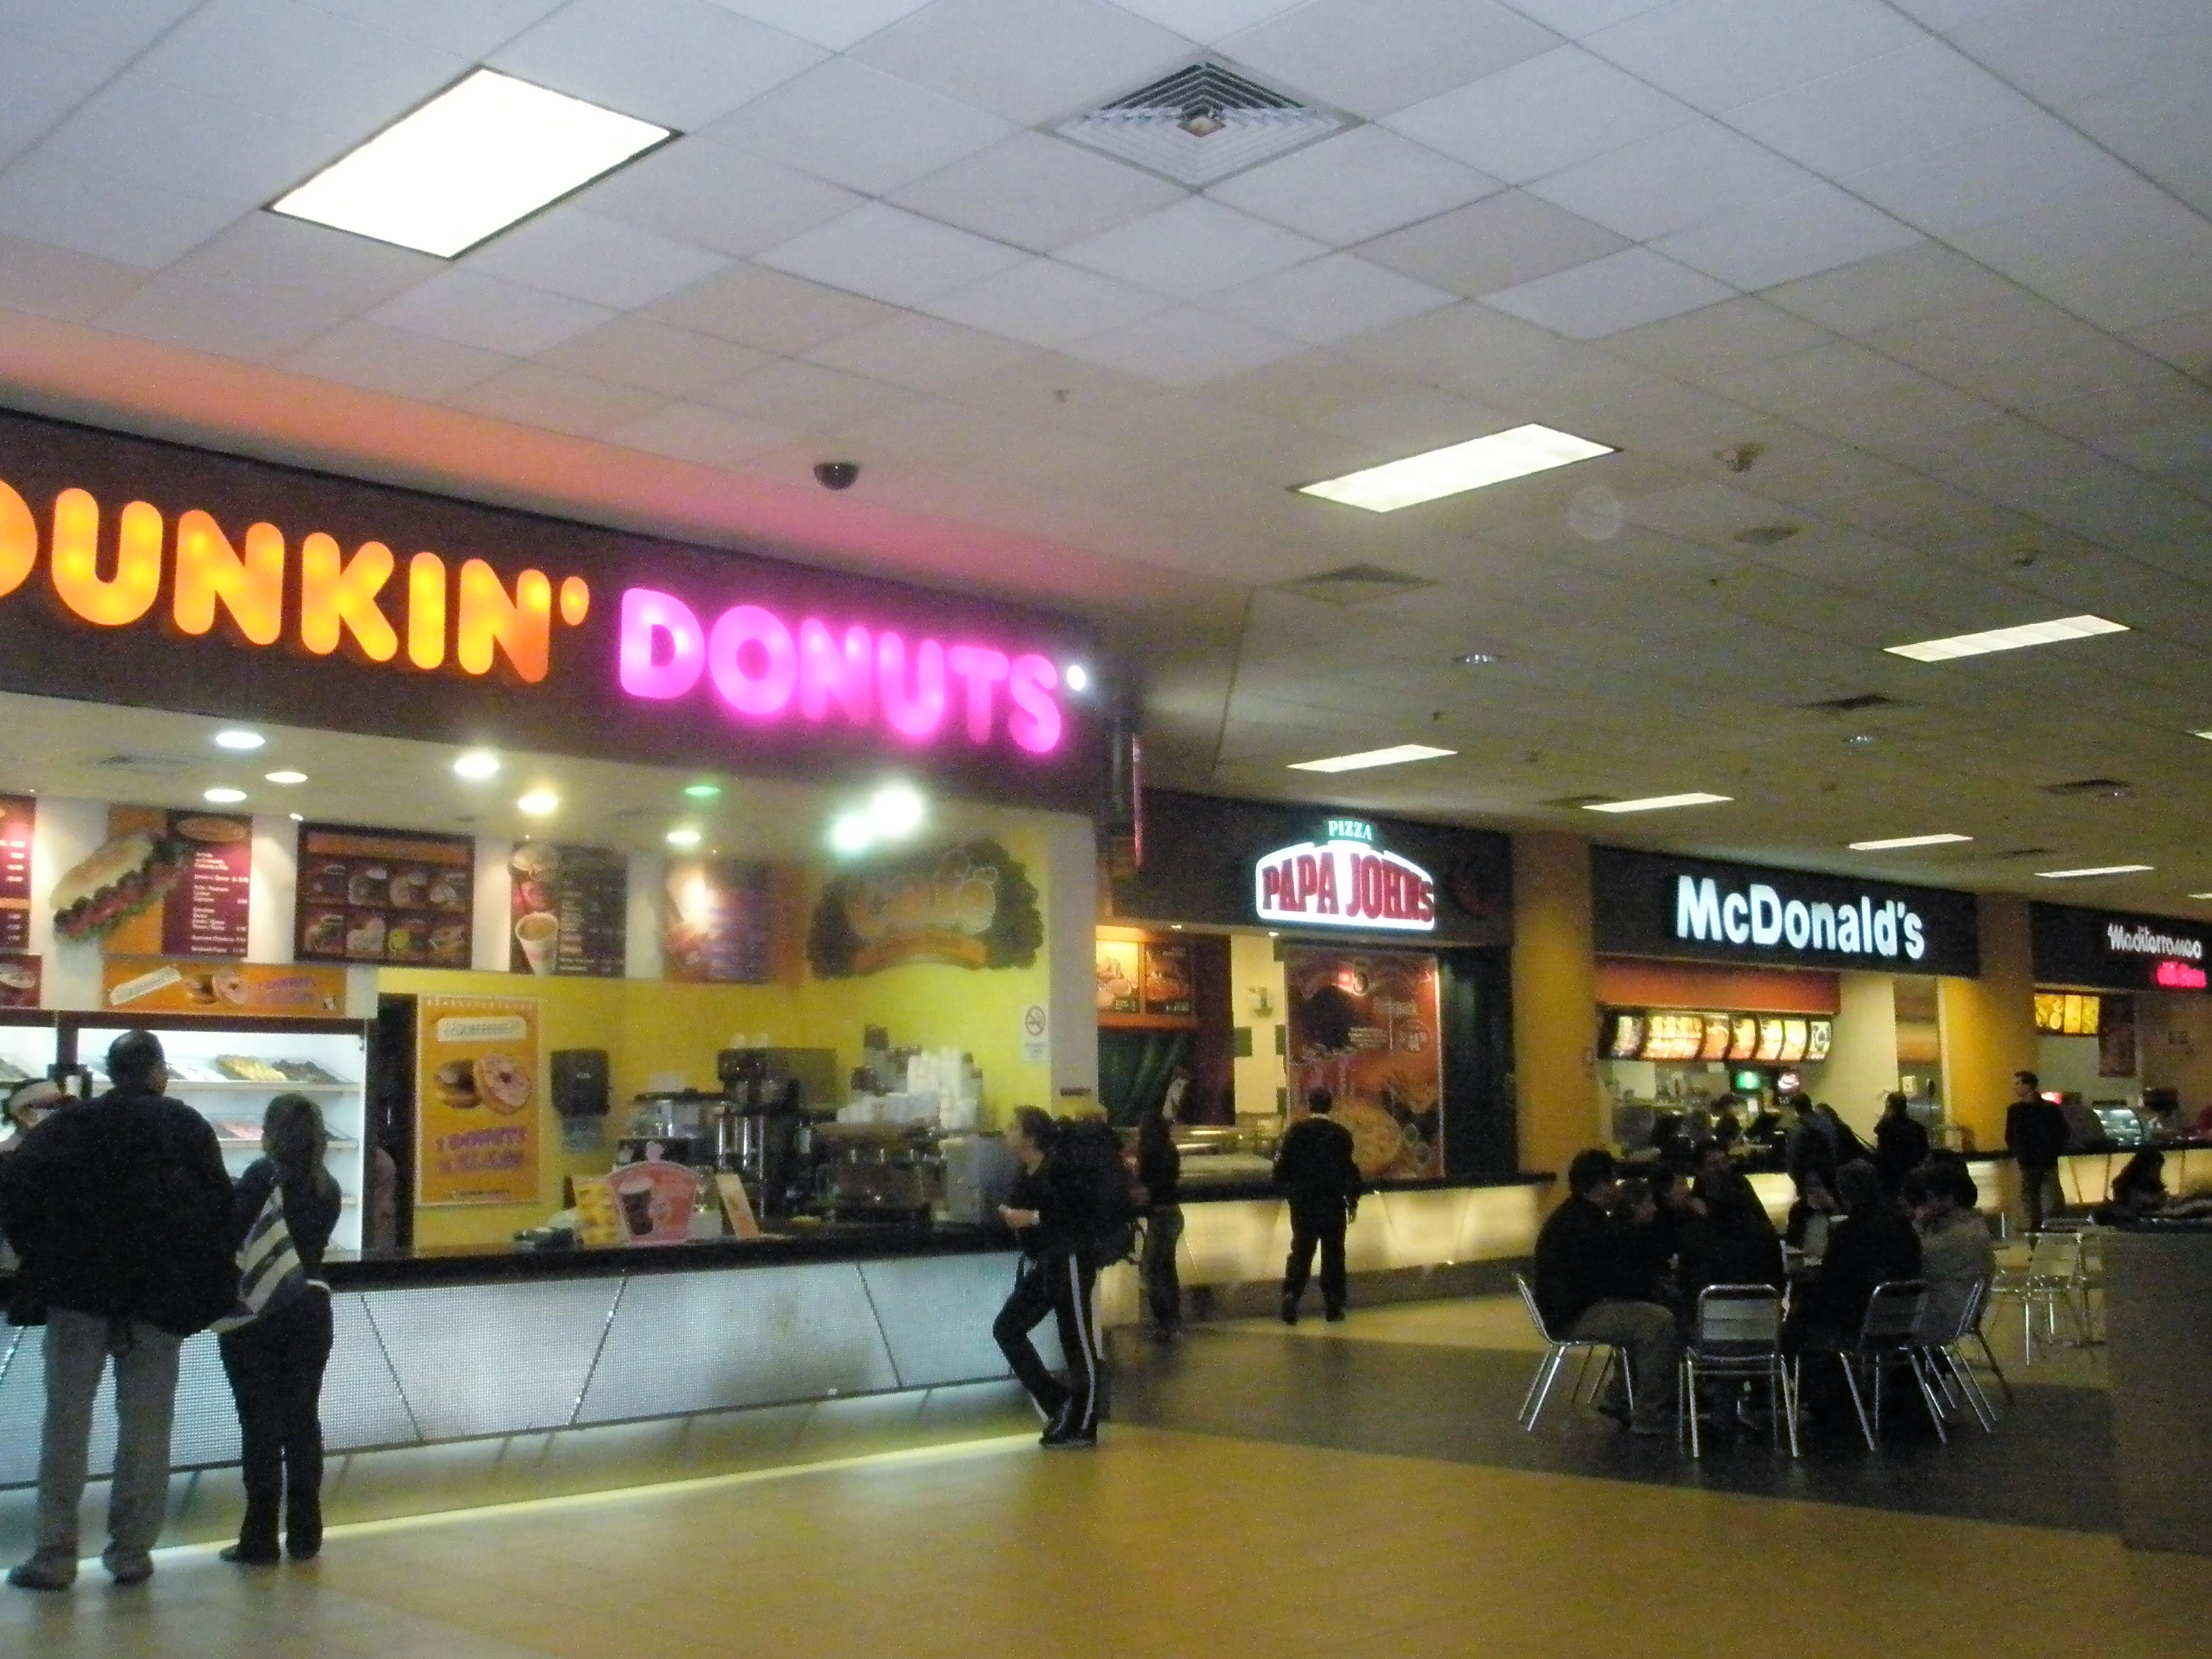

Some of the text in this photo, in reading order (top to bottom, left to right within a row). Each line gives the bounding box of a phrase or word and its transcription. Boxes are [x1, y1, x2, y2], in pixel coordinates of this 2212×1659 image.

[619, 587, 1062, 754] DONUTS
[1328, 820, 1372, 841] PIZZA
[1261, 852, 1340, 915] PAPA
[1676, 874, 1925, 960] McDonald's
